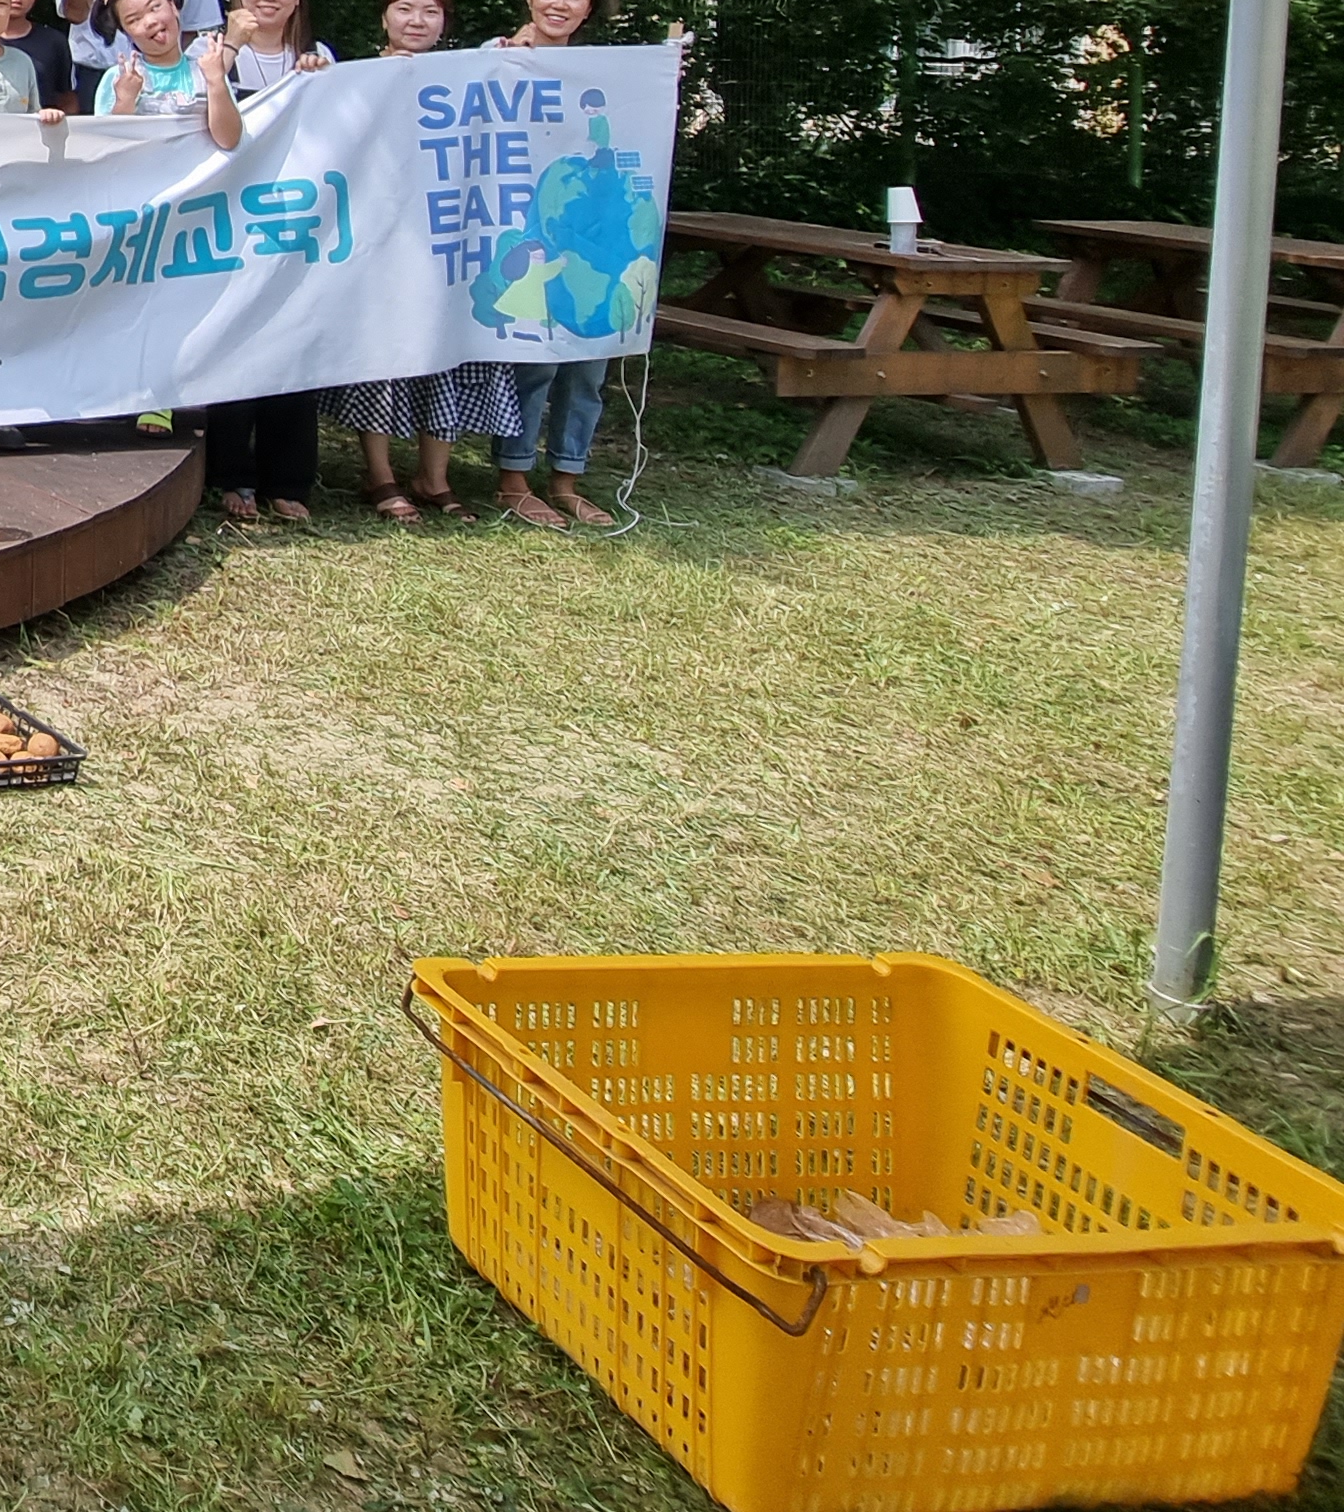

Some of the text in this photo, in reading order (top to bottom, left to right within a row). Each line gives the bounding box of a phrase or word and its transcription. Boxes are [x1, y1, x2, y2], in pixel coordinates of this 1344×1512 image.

[418, 80, 564, 130] SAVE
[420, 131, 532, 181] THE
[426, 184, 536, 235] EAR
[431, 236, 493, 287] TH
